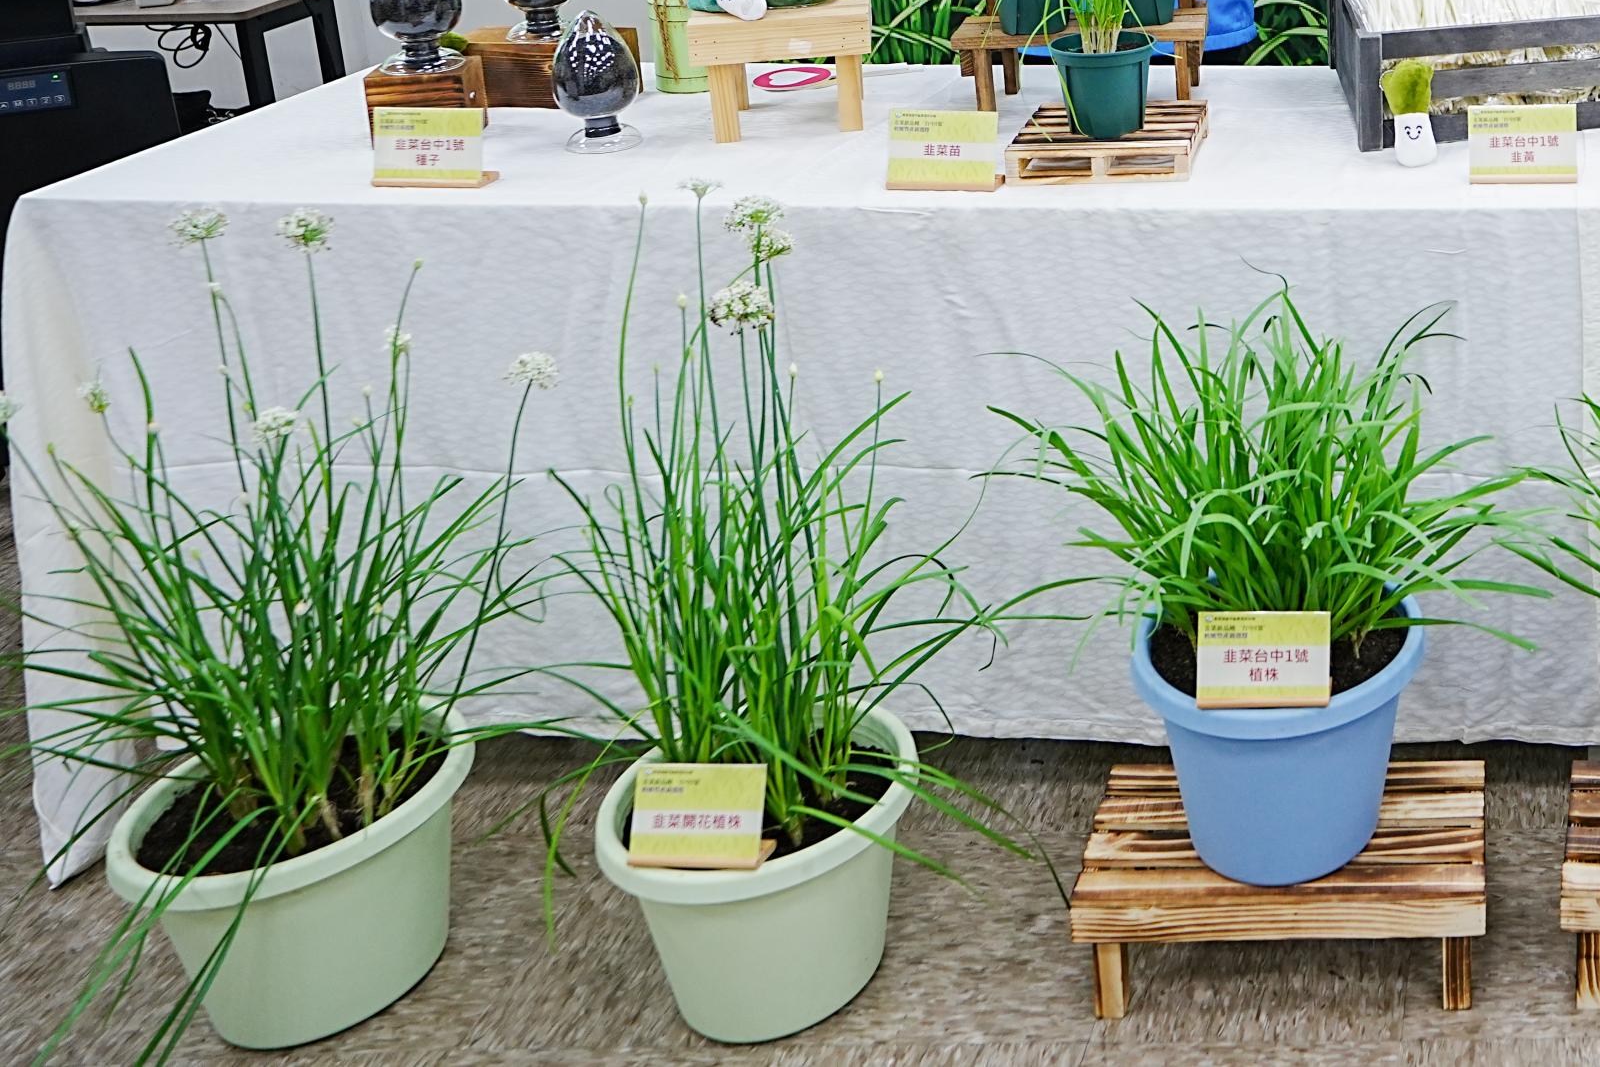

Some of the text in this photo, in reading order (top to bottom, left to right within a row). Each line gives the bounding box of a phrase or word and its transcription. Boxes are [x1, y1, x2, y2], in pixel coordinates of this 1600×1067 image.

[395, 138, 465, 151] 韭菜台中1號
[1489, 135, 1560, 149] 韭菜台中1號
[923, 143, 961, 157] 韭菜苗
[1223, 648, 1310, 663] 韭菜台中1號
[1249, 667, 1279, 682] 植株
